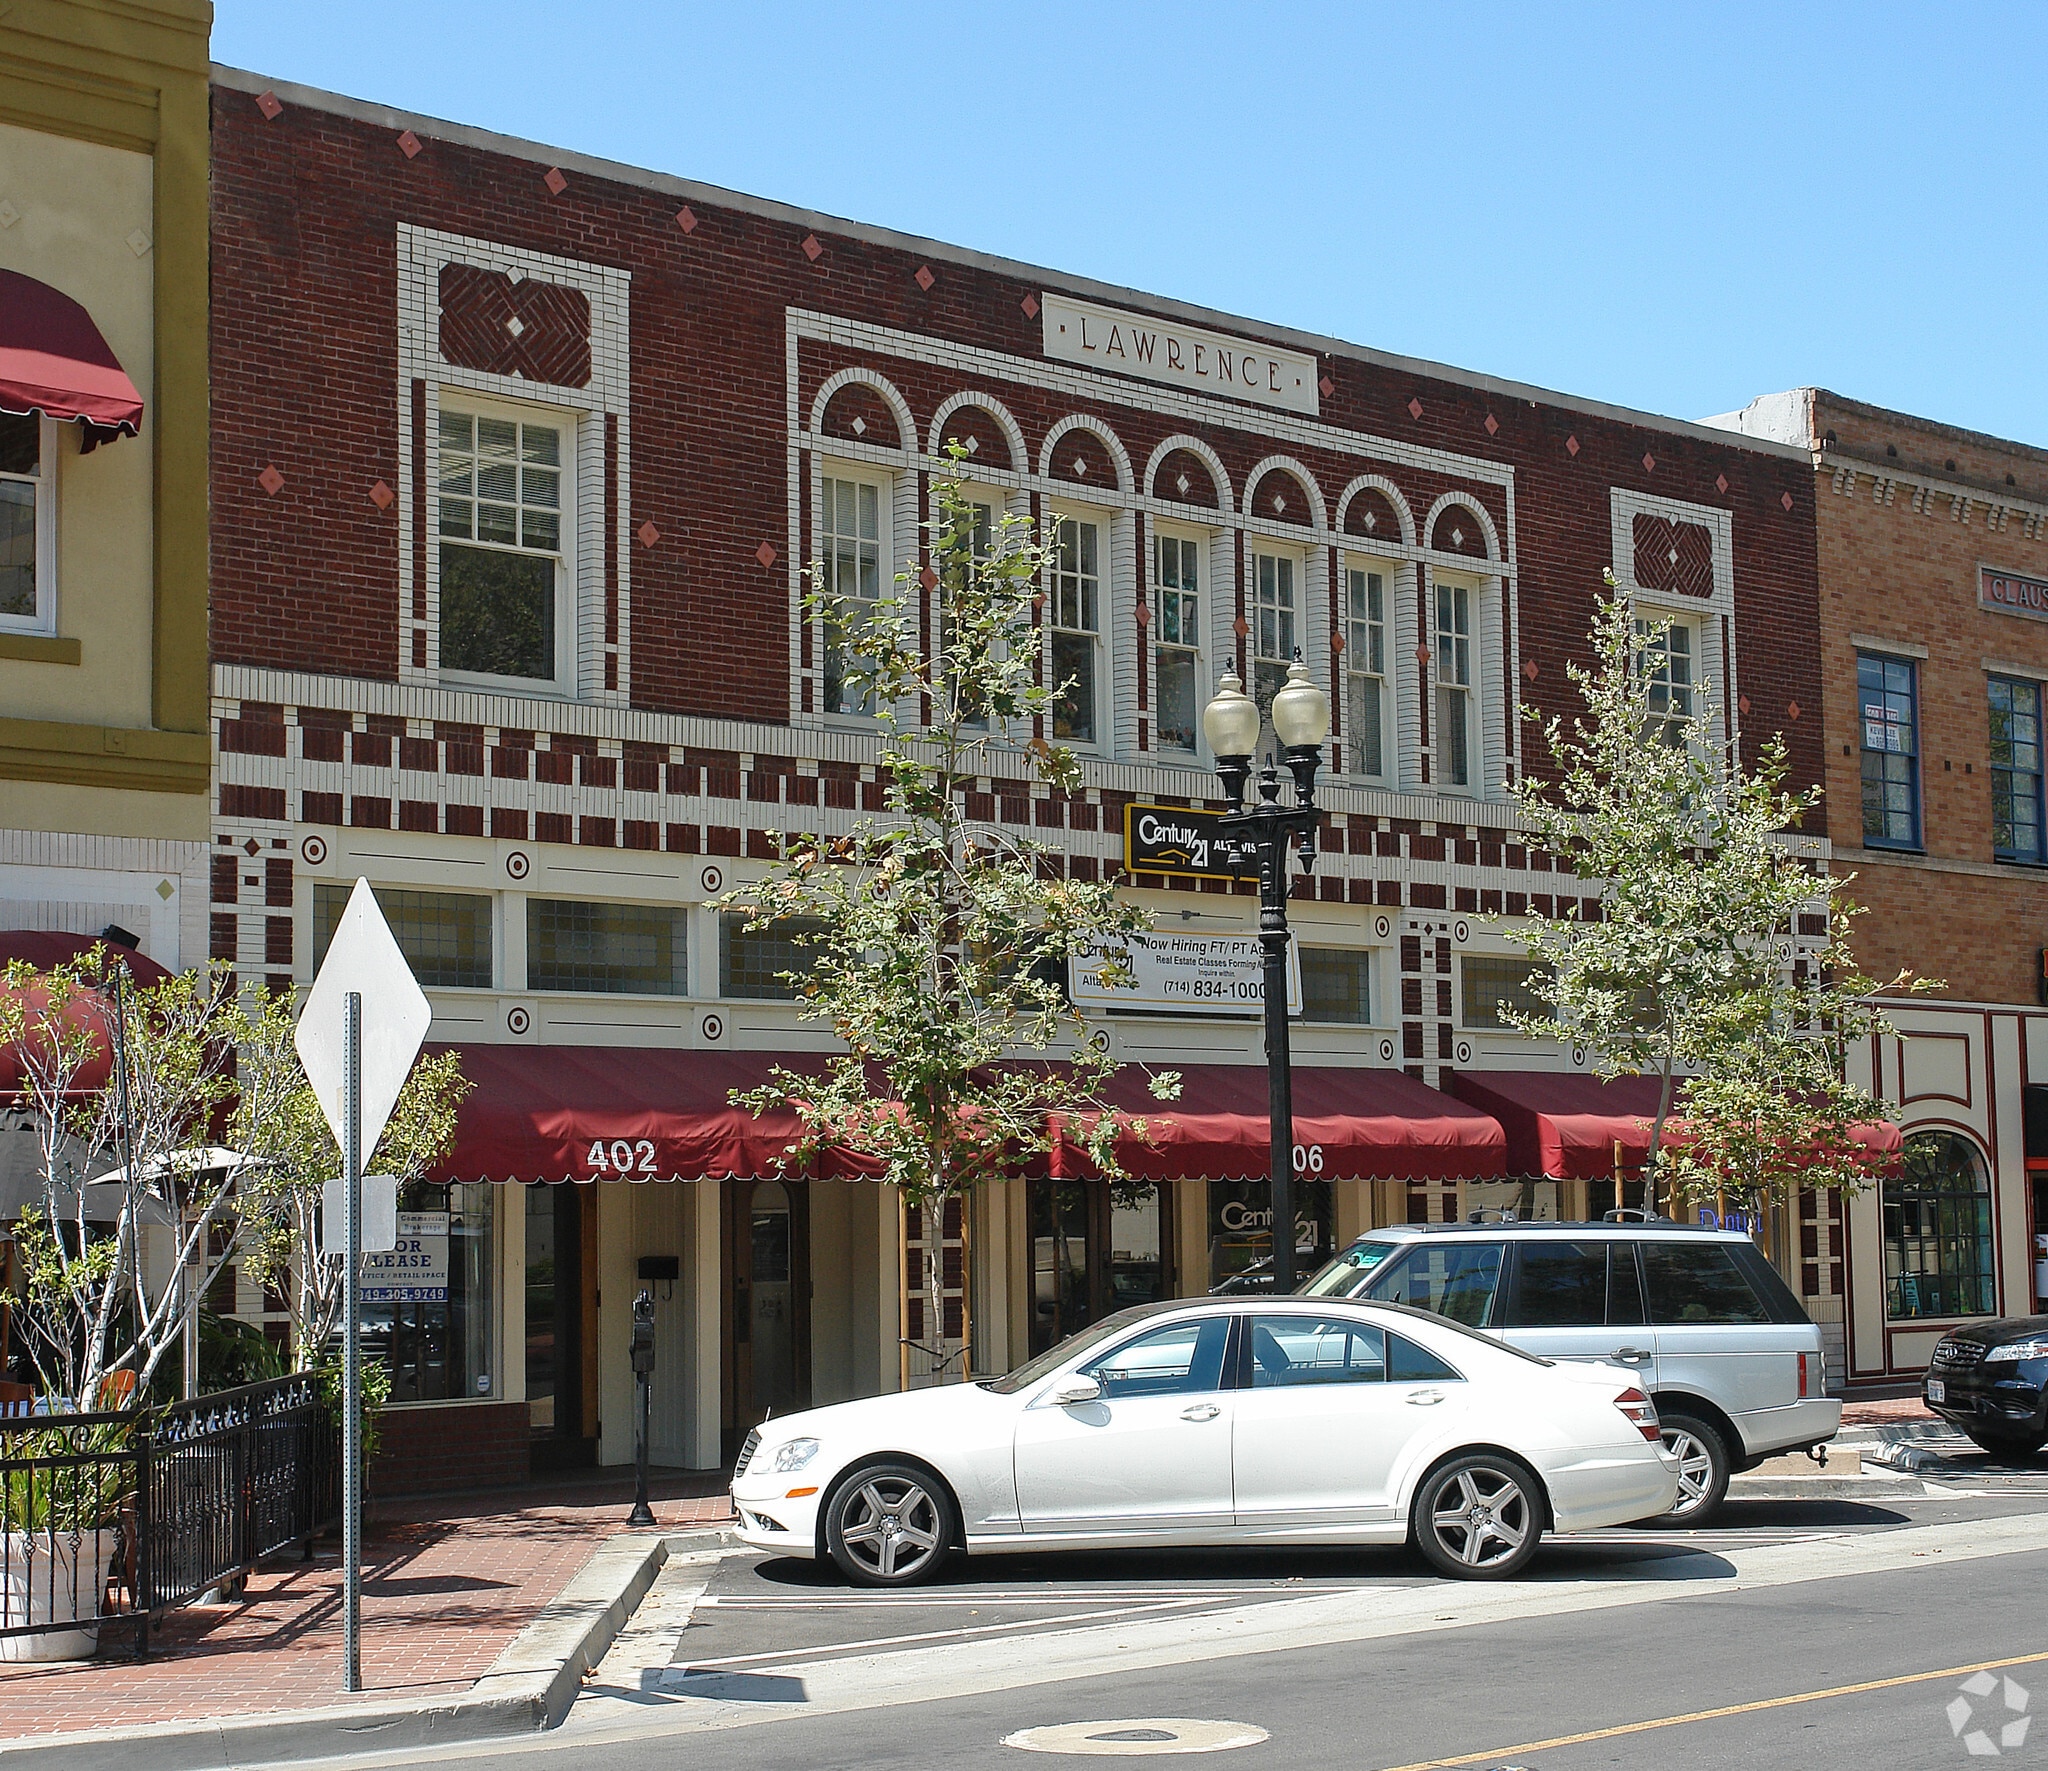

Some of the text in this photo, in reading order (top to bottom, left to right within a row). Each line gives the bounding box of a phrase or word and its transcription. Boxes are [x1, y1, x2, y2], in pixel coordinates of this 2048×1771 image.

[1080, 317, 1282, 392] LAWRENCE
[1138, 815, 1198, 848] Century
[1190, 840, 1257, 867] 21 ALT VIS
[1141, 937, 1169, 950] Now
[1171, 938, 1207, 955] Hiring
[1232, 942, 1247, 954] PT
[1156, 955, 1173, 965] Real
[1174, 956, 1197, 966] Estate
[1198, 957, 1228, 967] Classes
[1228, 959, 1257, 970] Forming
[1163, 980, 1190, 994] (714)
[587, 1140, 658, 1172] 402
[1292, 1145, 1324, 1172] 06
[1221, 1202, 1303, 1230] Cent
[382, 1240, 422, 1252] OR
[1295, 1220, 1318, 1247] 21
[371, 1255, 431, 1267] LEASE
